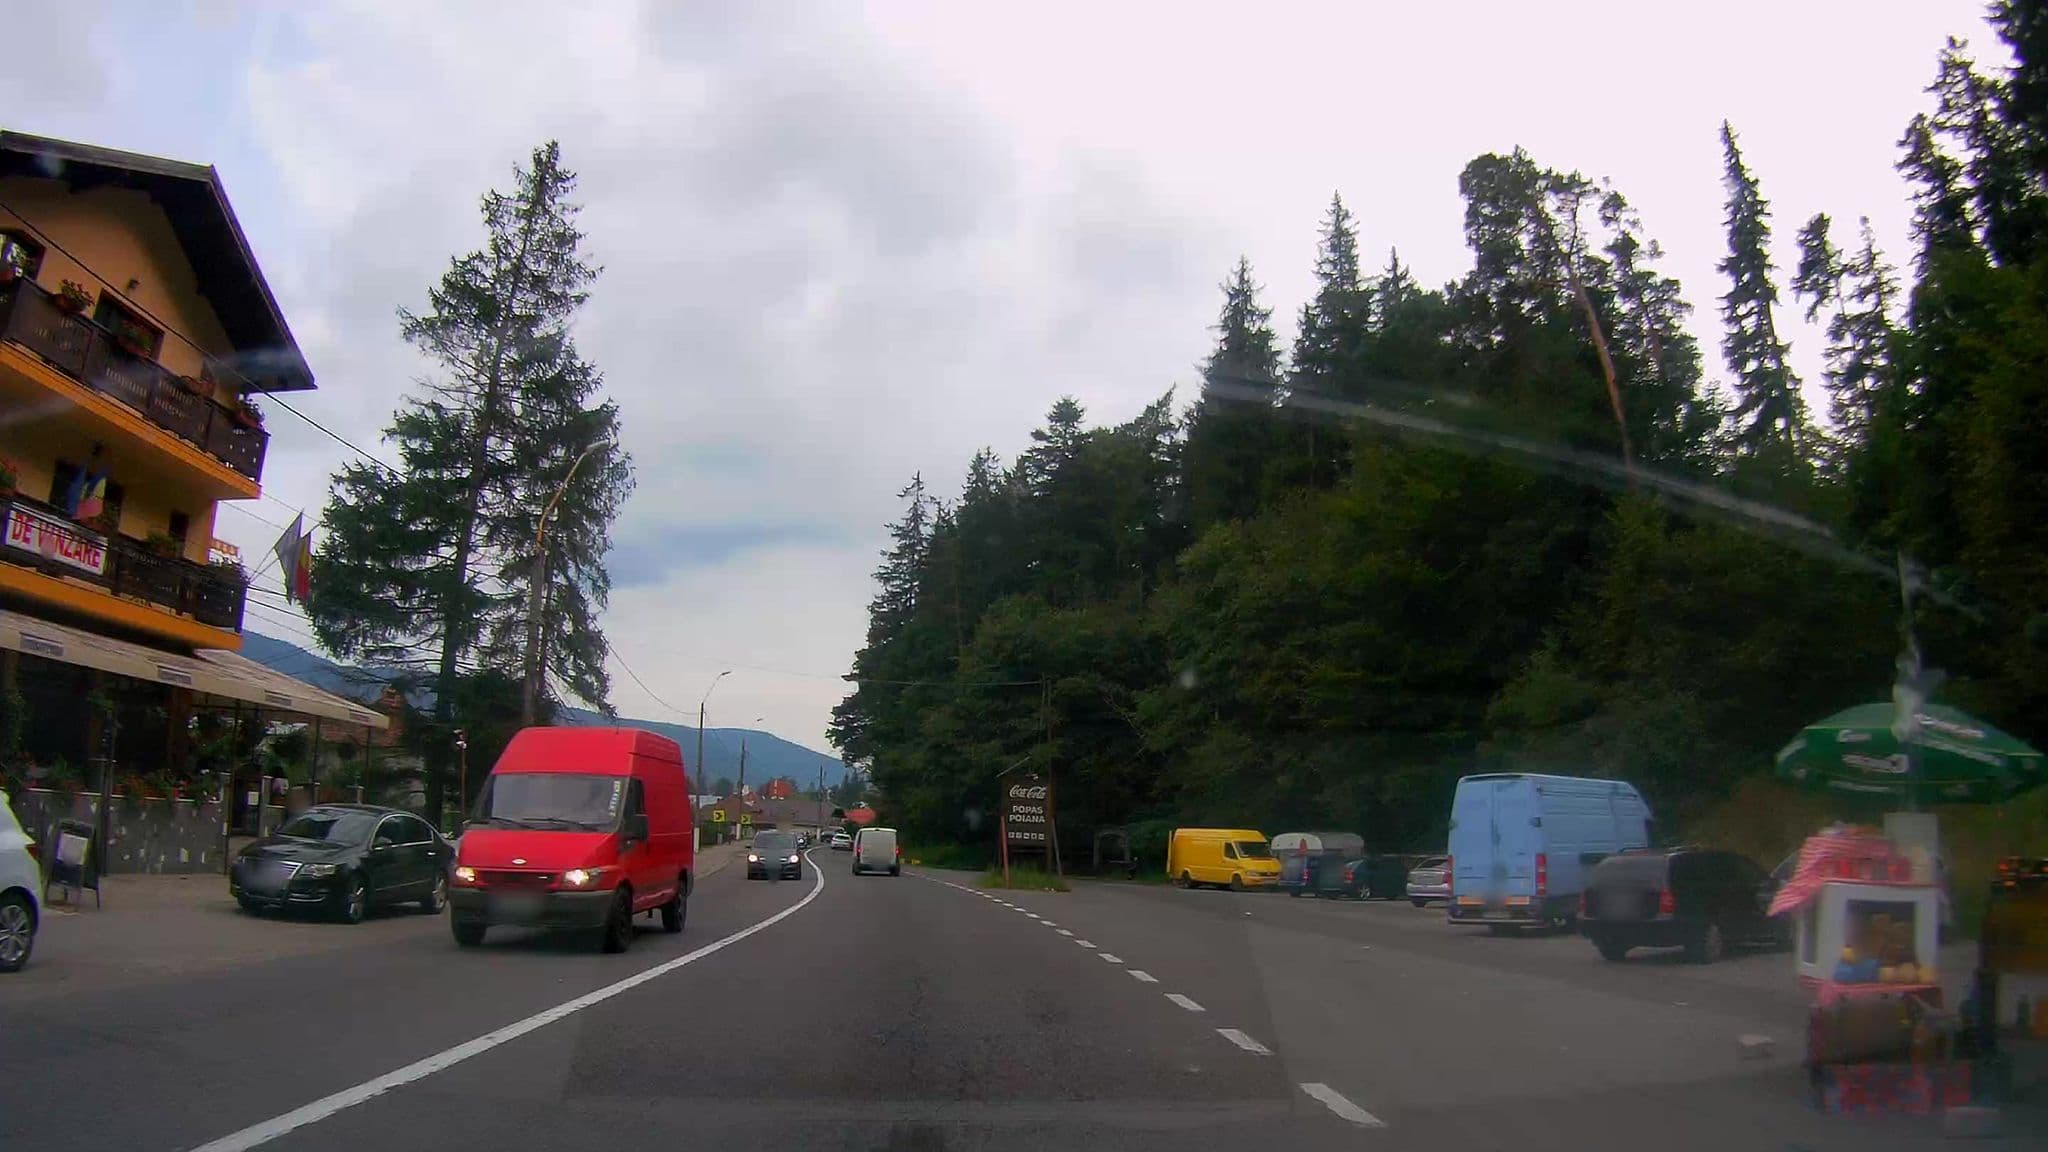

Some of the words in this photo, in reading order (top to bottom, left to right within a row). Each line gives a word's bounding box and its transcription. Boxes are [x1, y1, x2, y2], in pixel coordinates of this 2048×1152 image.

[12, 513, 34, 545] DE
[1009, 785, 1046, 799] Coca-Cola
[1012, 805, 1044, 814] POPAS
[1009, 814, 1046, 823] POIANA
